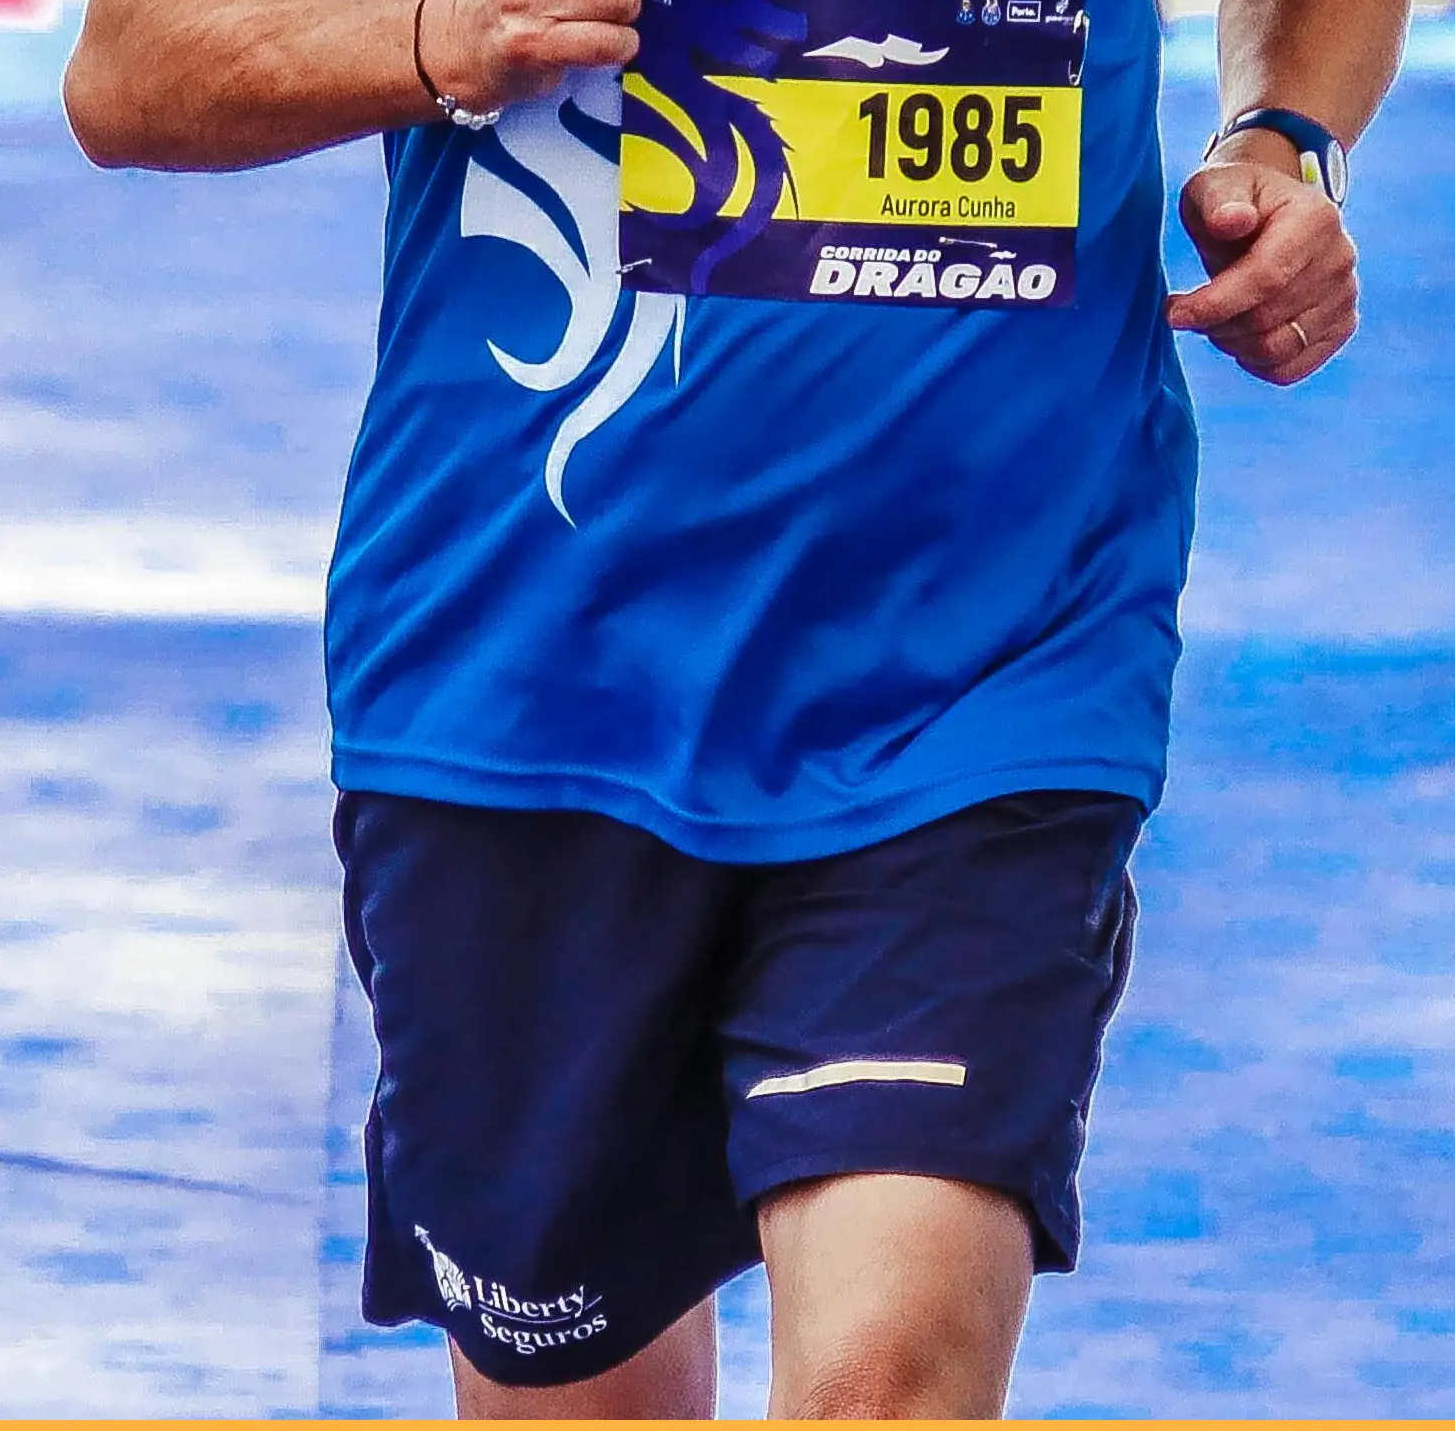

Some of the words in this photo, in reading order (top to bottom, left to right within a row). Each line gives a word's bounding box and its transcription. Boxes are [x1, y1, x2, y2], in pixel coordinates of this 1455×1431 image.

[859, 92, 1043, 183] 1985
[881, 193, 951, 218] Aurora
[958, 195, 1016, 219] Cunha
[820, 245, 912, 263] CORRIDA
[913, 248, 942, 263] DO
[809, 251, 1057, 300] DRAGÃO
[473, 1276, 586, 1318] Liberty
[481, 1312, 608, 1355] Seguros
